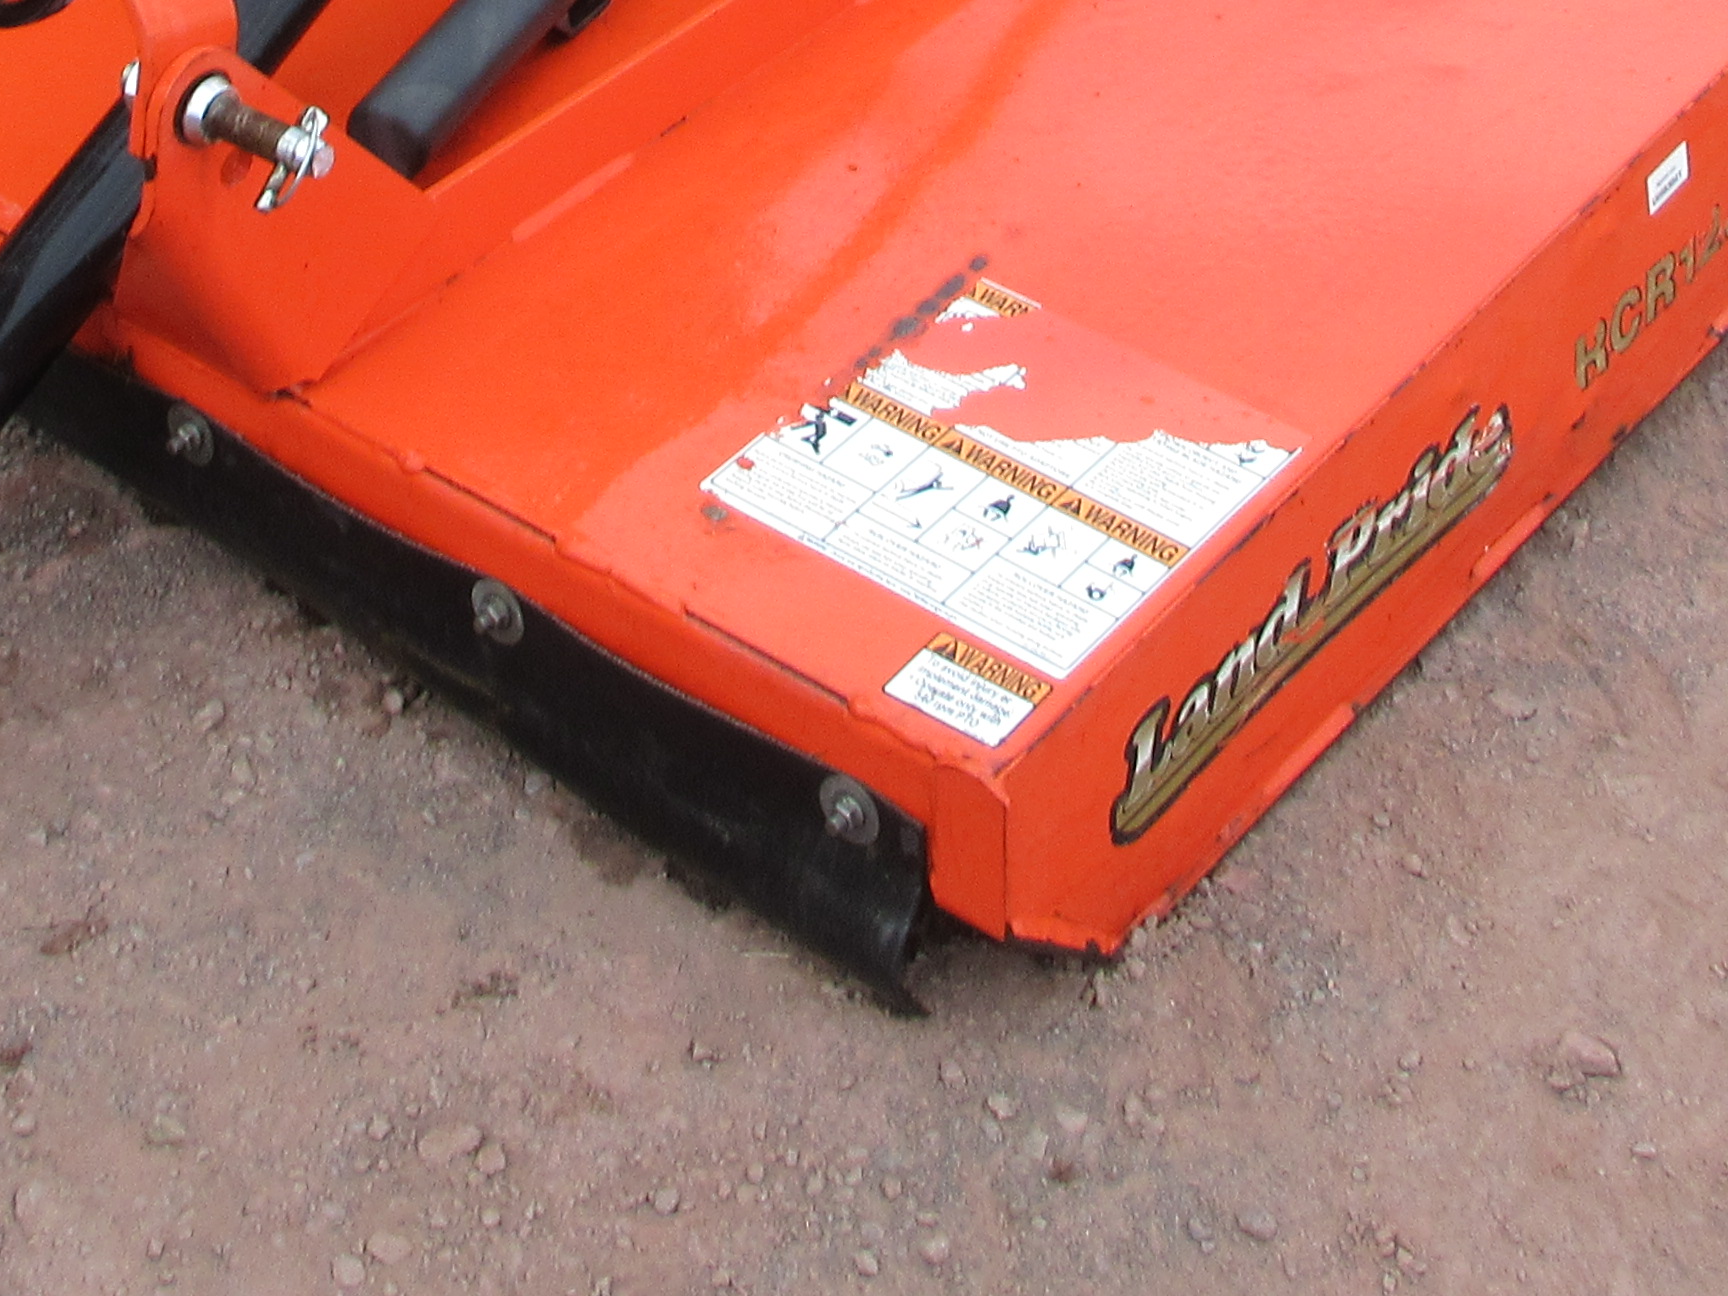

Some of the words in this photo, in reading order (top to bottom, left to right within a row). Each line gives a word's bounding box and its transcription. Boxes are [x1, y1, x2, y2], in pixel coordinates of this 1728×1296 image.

[853, 387, 941, 441] WARNING
[966, 444, 1057, 500] WARNING
[1081, 505, 1179, 564] WARNING
[961, 643, 1042, 699] WARNING
[1120, 557, 1310, 814] Land
